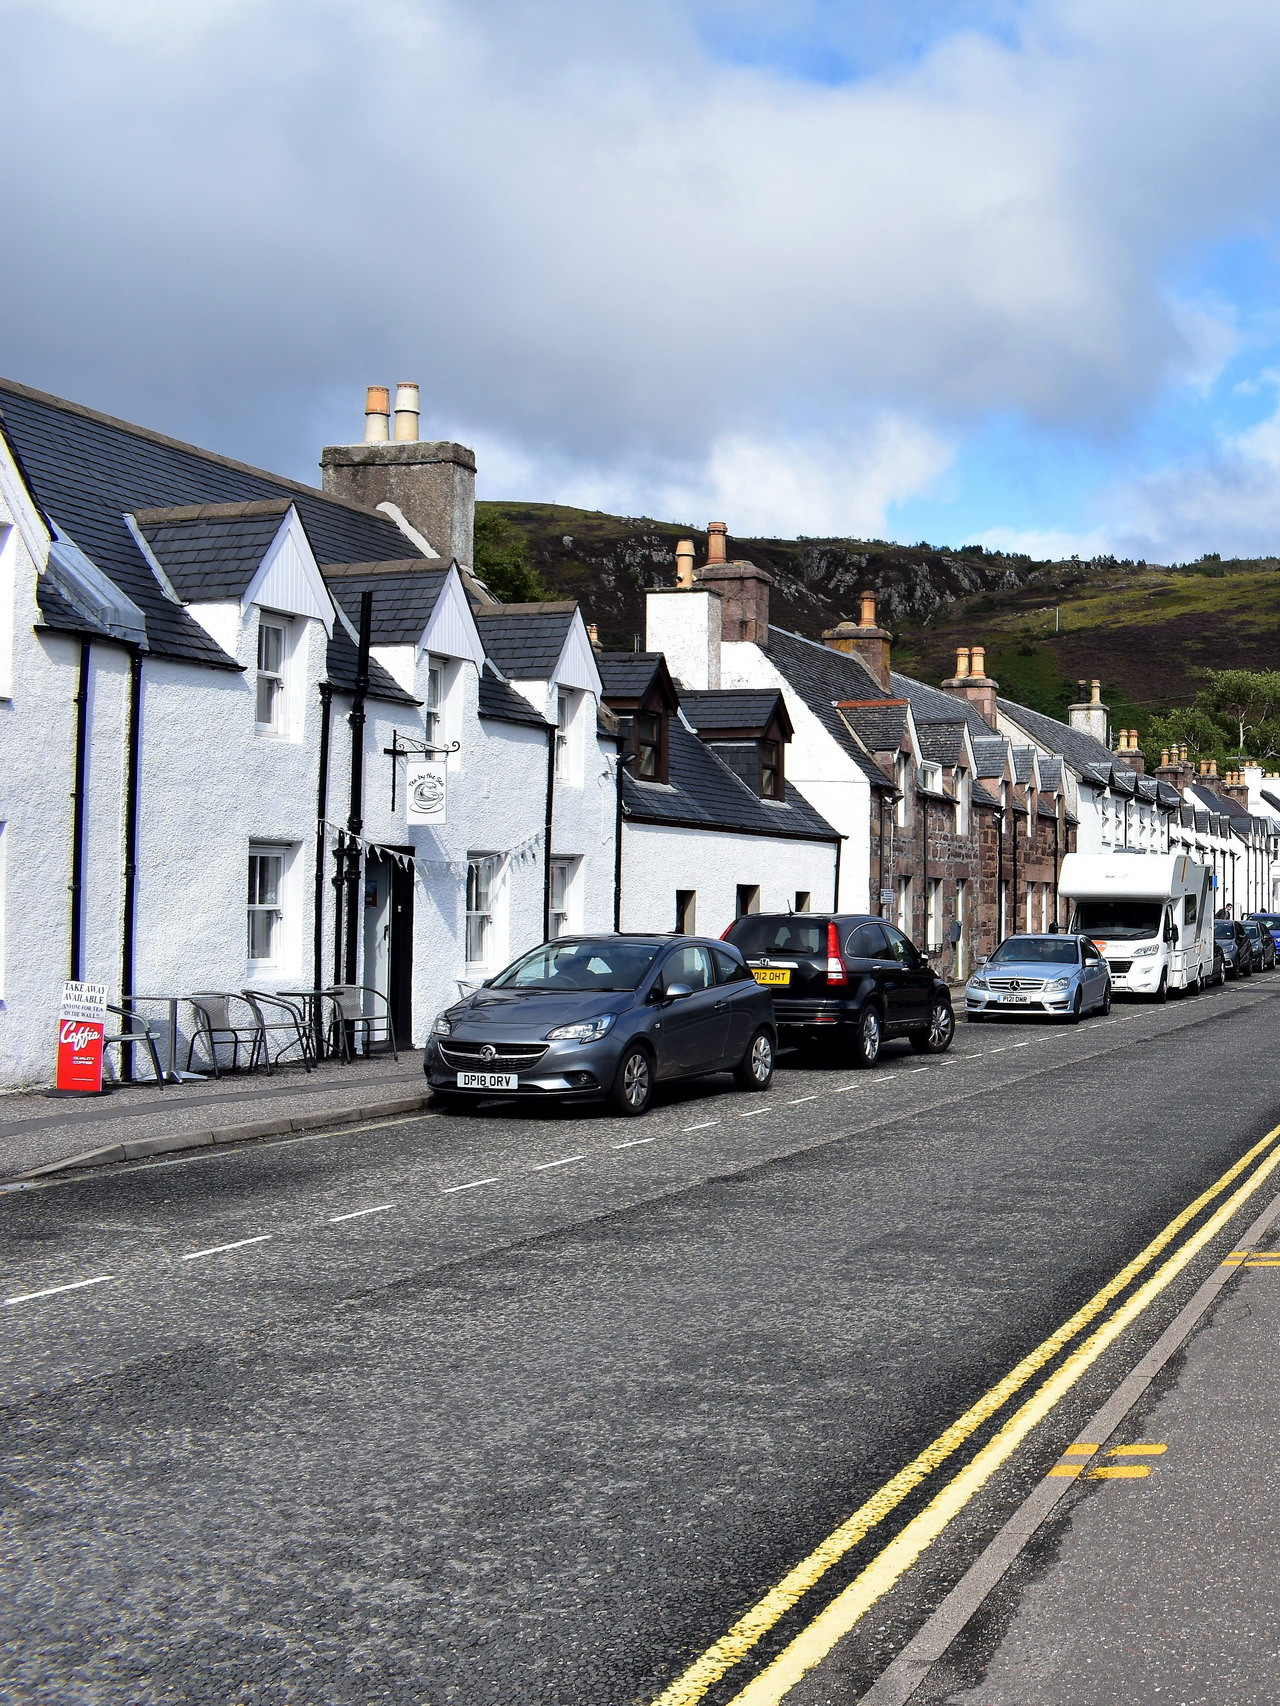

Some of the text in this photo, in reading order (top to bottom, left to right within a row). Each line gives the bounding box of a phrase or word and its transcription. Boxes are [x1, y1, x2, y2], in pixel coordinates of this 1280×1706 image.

[64, 982, 105, 994] TAKE AWAY
[64, 992, 104, 1004] AVAILABLE
[61, 1021, 101, 1051] Caffia
[463, 1074, 511, 1087] DP18 ORV
